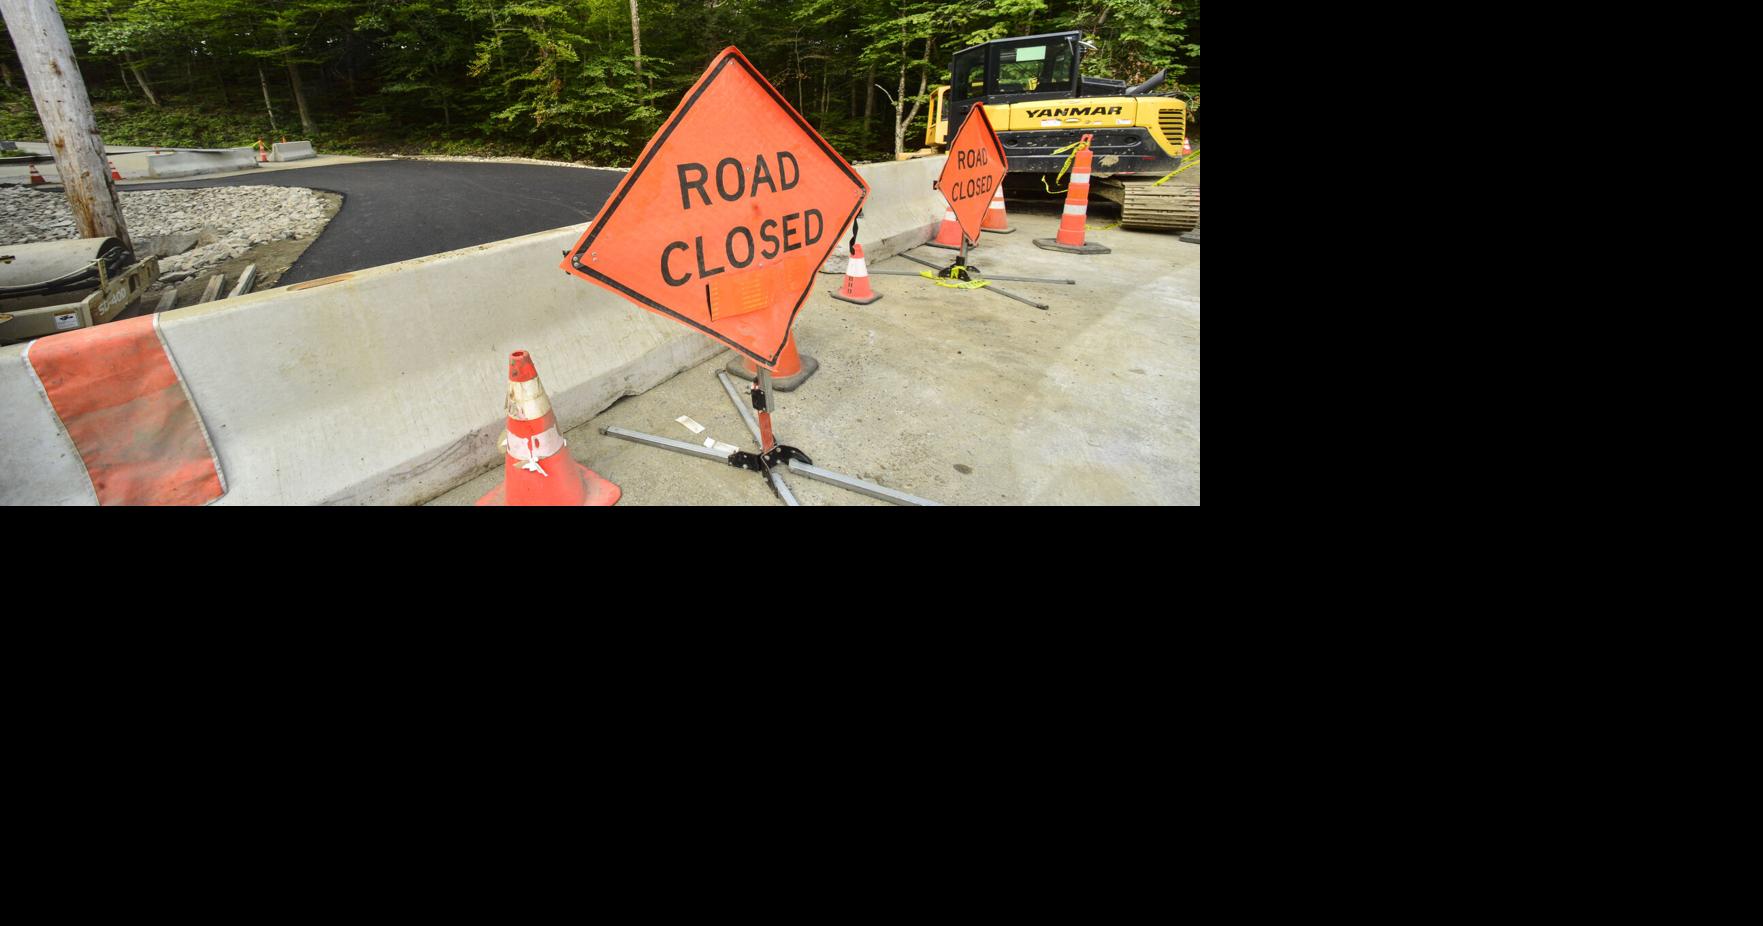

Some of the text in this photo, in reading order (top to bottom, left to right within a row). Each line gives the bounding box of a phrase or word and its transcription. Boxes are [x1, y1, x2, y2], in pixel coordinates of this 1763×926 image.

[1026, 106, 1122, 118] YANMAR
[957, 147, 988, 170] ROAD
[677, 150, 800, 210] ROAD
[952, 174, 993, 202] CLOSED
[660, 208, 824, 287] CLOSED
